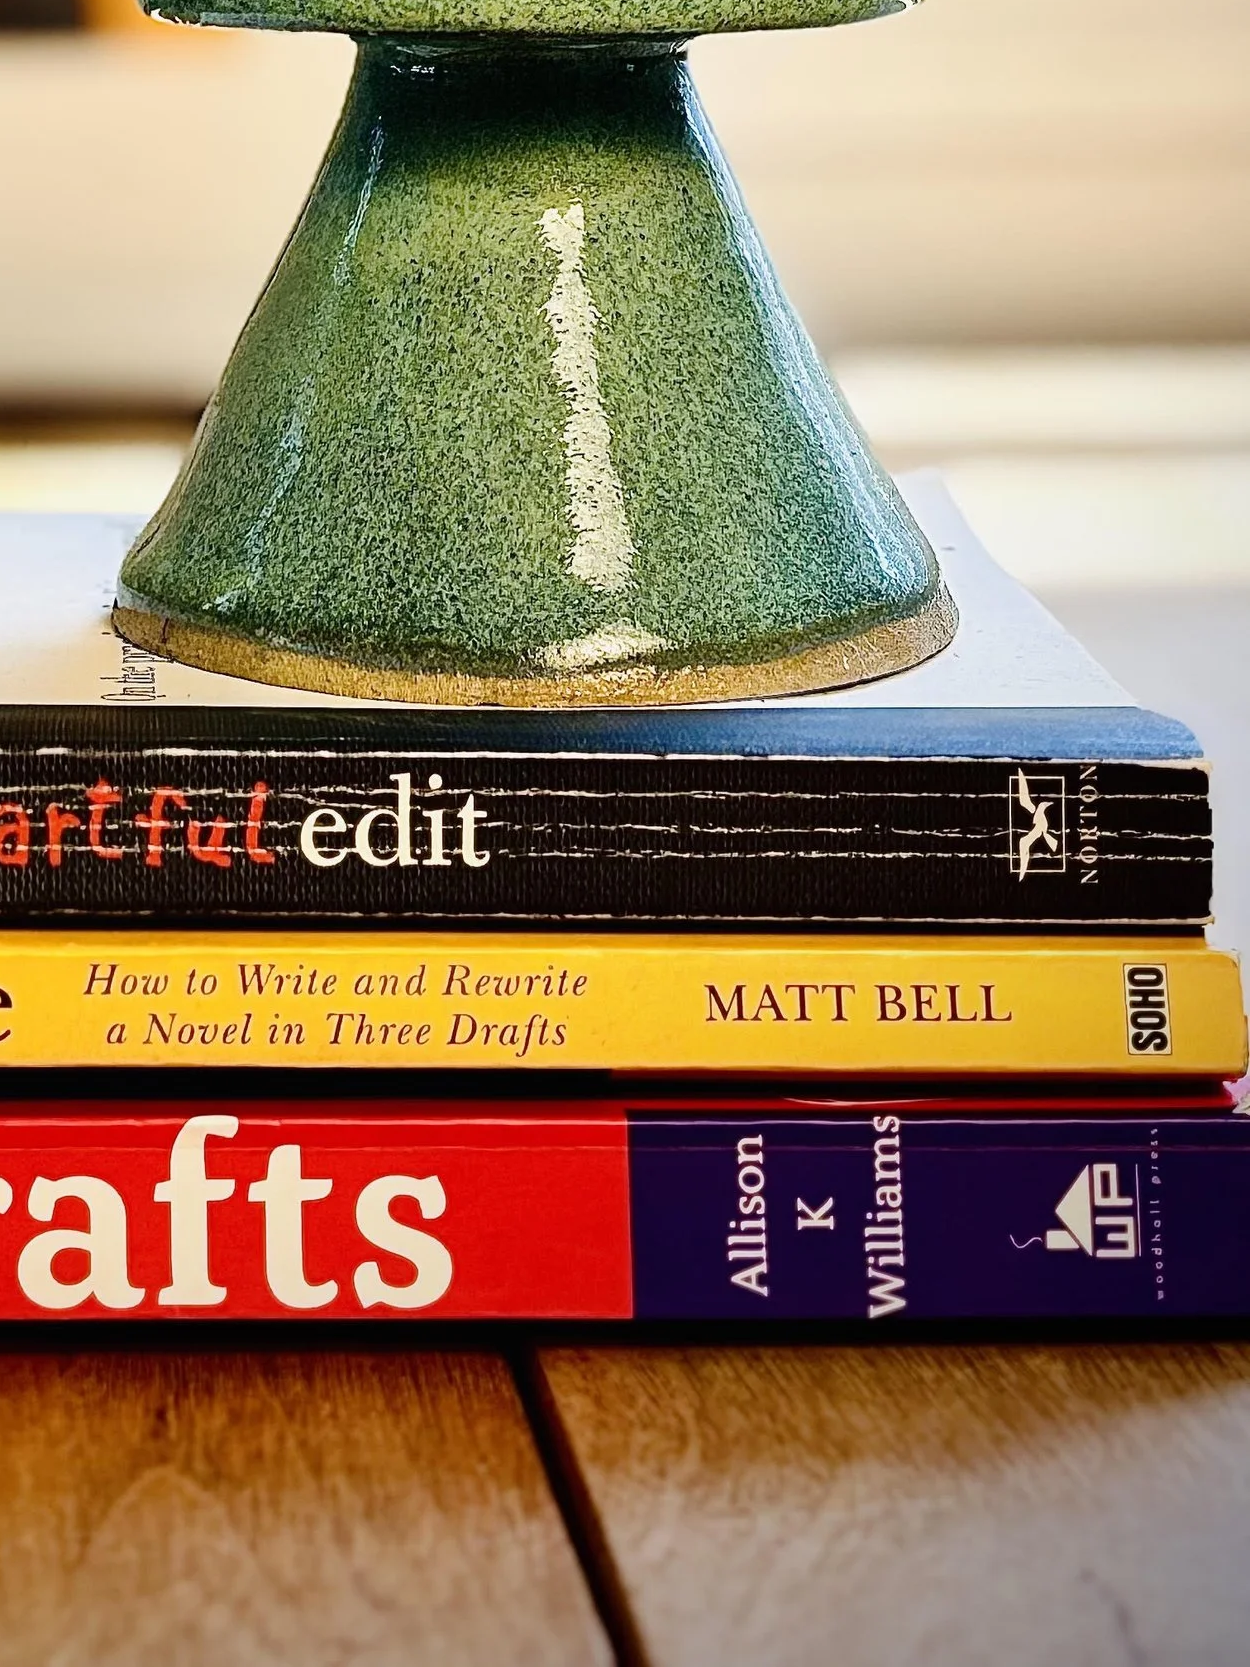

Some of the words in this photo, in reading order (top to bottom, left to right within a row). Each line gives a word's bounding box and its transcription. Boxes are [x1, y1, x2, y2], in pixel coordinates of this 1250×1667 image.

[299, 772, 491, 868] edit
[1079, 764, 1099, 884] NORTON
[83, 963, 169, 996] How
[185, 968, 219, 996] to
[237, 963, 337, 996] Write
[353, 963, 427, 996] and
[441, 963, 589, 996] Rewrite
[703, 983, 857, 1022] MATT
[873, 983, 1013, 1022] BELL
[1127, 966, 1169, 1052] SOHO
[105, 1020, 128, 1046] a
[142, 1012, 253, 1046] Novel
[268, 1012, 306, 1046] in
[325, 1012, 432, 1046] Three
[445, 1012, 569, 1058] Drafts
[727, 1133, 769, 1298] Allison
[796, 1196, 835, 1231] K
[864, 1115, 907, 1319] Williams
[1092, 1163, 1136, 1258] WP
